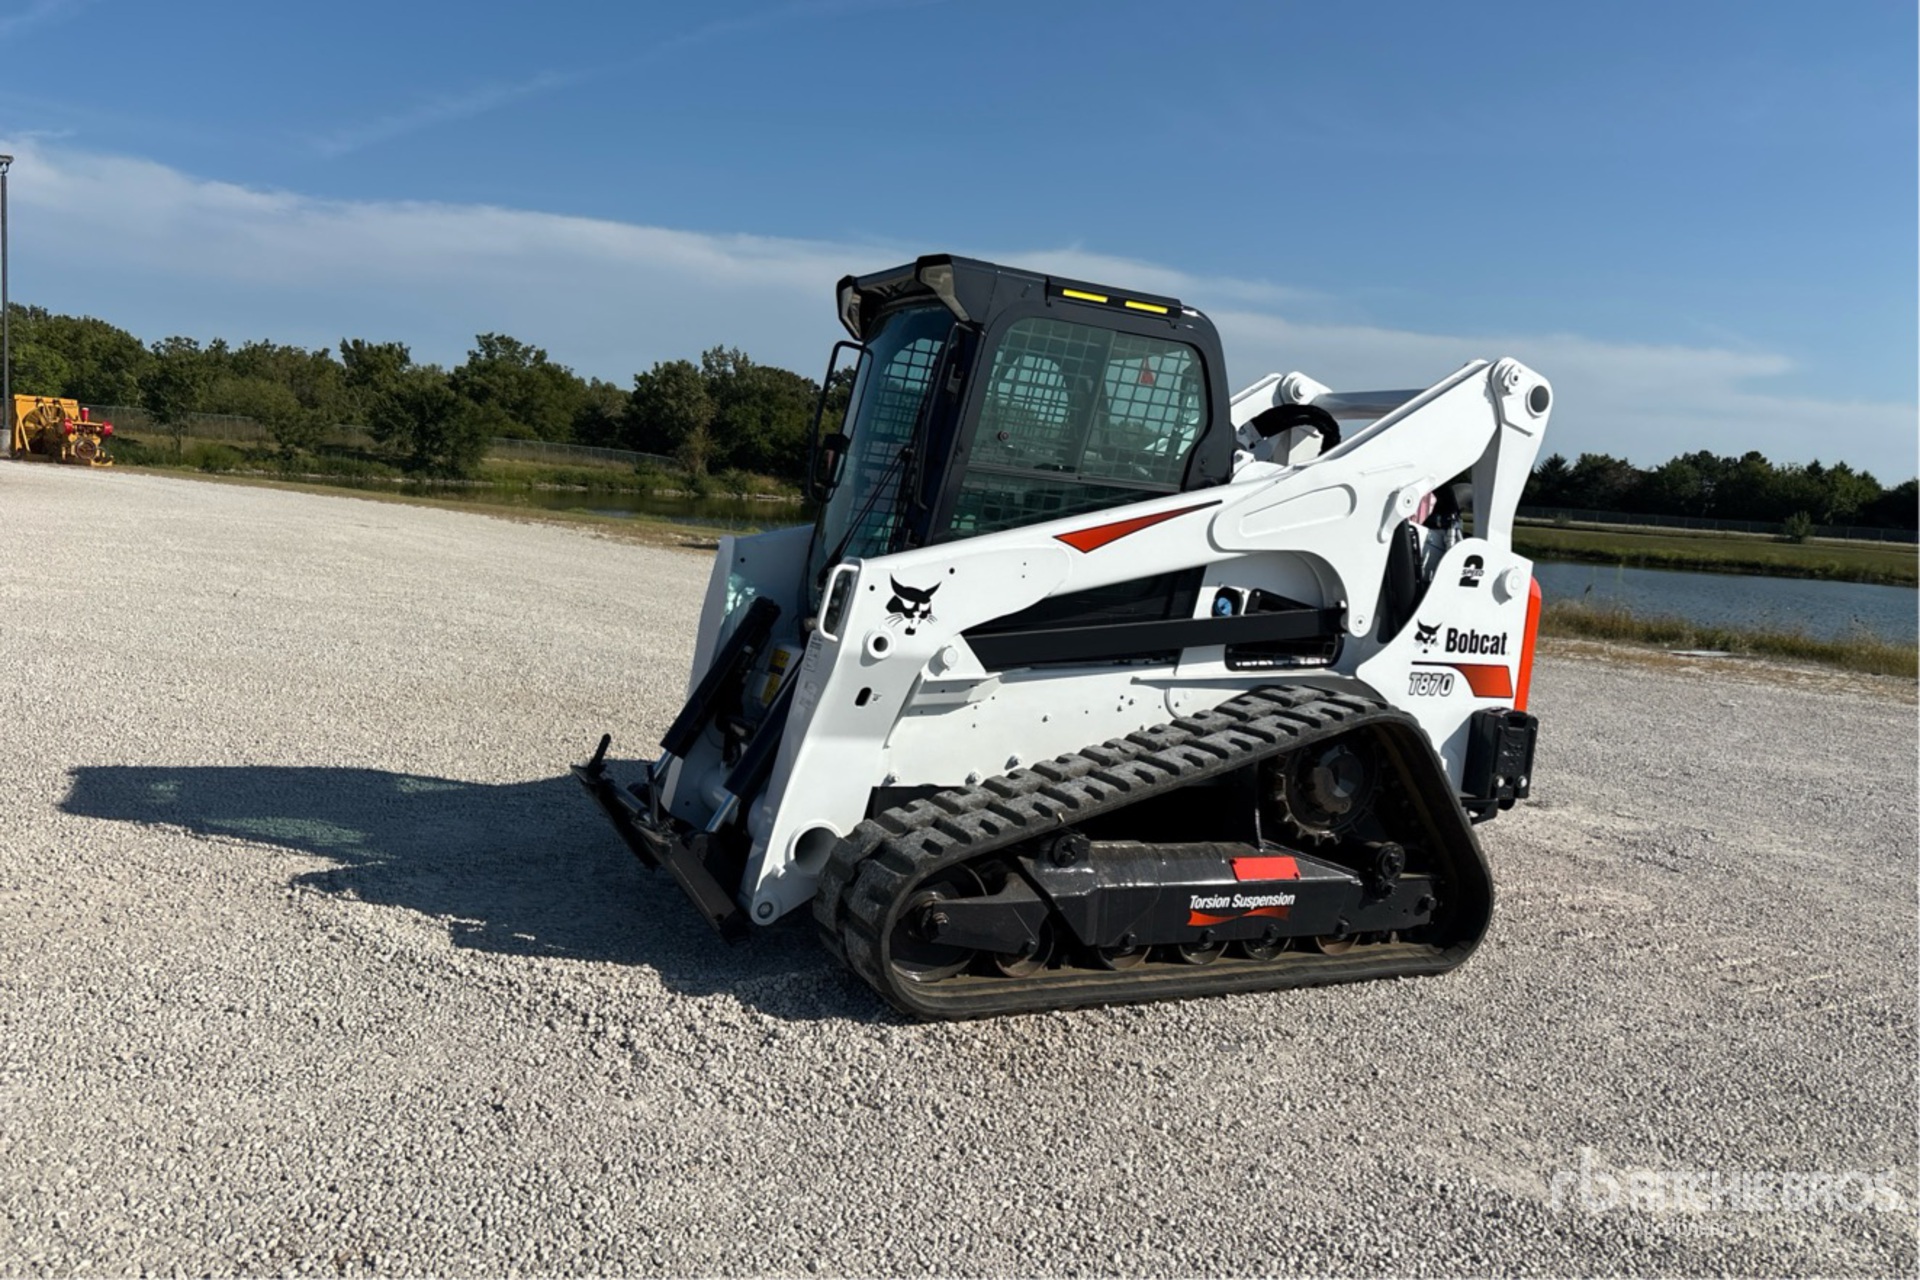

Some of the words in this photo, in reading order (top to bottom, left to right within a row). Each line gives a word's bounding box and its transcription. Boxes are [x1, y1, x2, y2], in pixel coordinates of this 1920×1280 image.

[1459, 554, 1484, 588] 2
[1462, 569, 1484, 577] SPEED
[1445, 627, 1508, 655] Bobcat
[1408, 672, 1454, 697] T870
[1189, 894, 1230, 909] Torsion
[1232, 892, 1295, 910] Suspension
